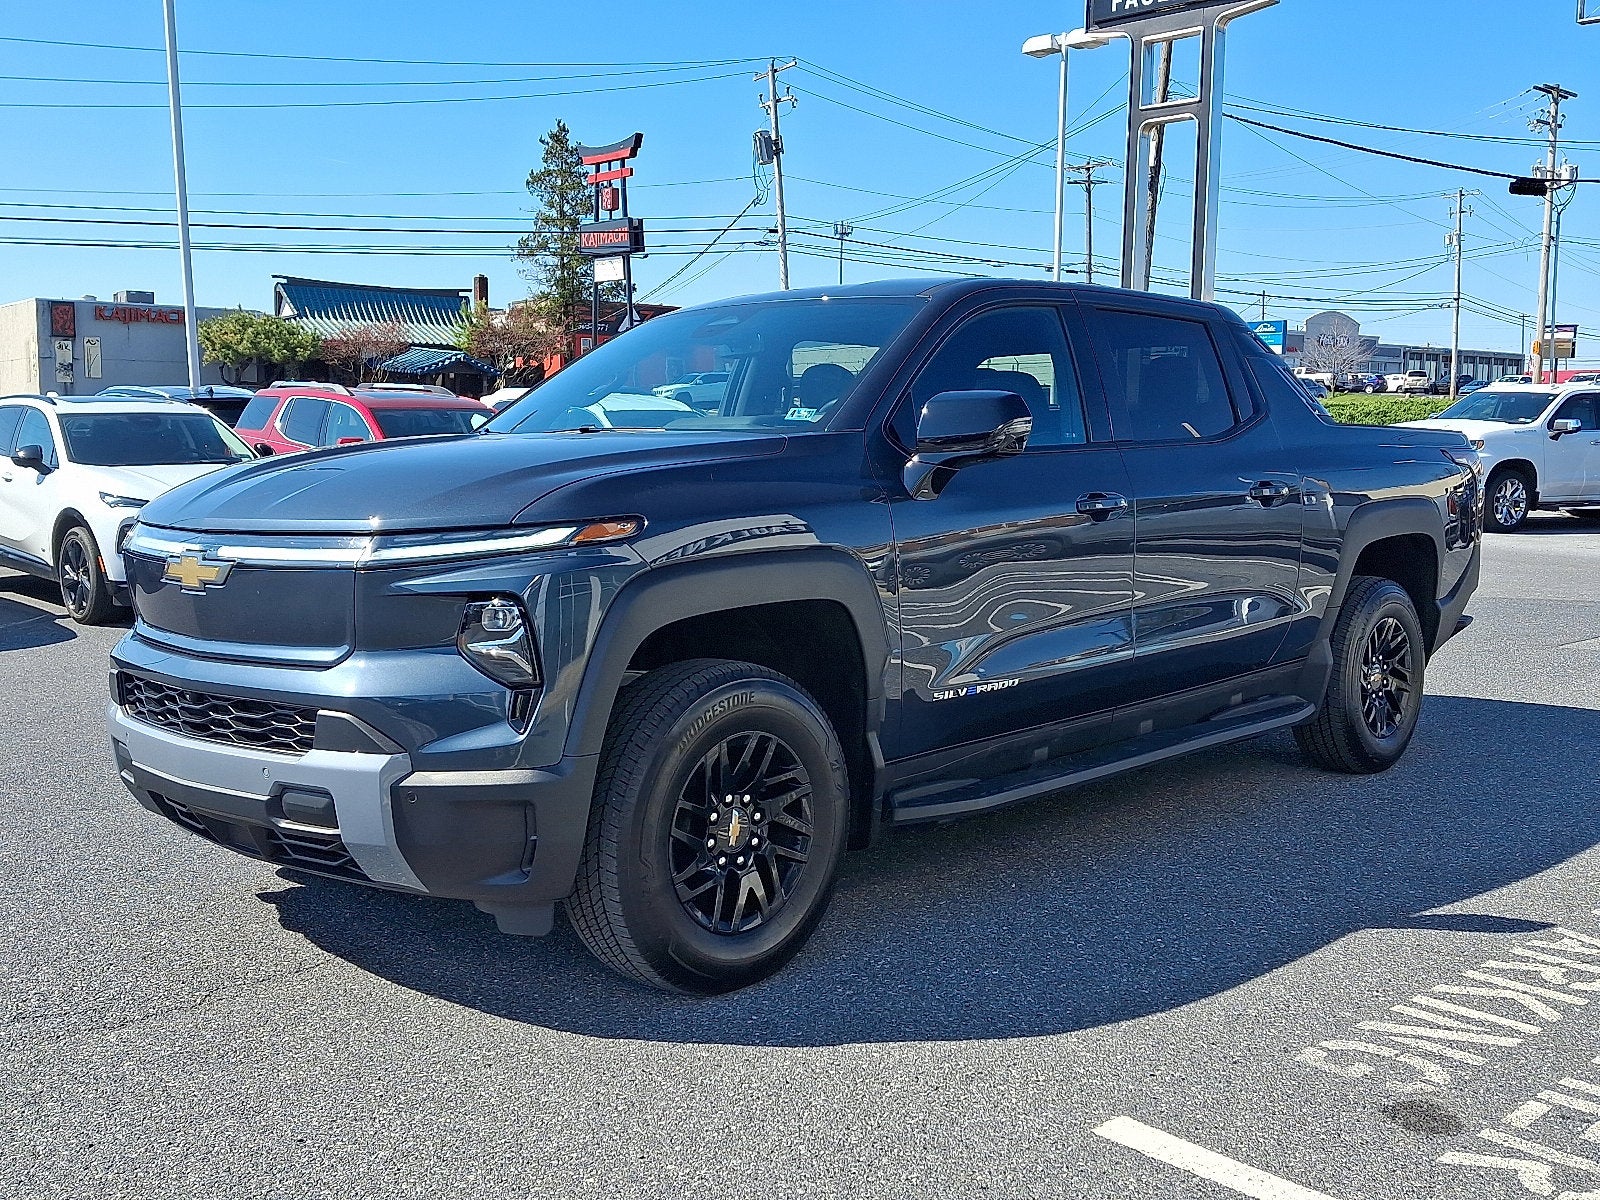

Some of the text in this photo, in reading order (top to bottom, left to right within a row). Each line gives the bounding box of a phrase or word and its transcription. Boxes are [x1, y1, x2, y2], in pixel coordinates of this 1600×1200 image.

[95, 305, 185, 324] KAJIMAC
[932, 679, 1021, 702] SILVERADO
[1294, 910, 1600, 1092] ARKING
